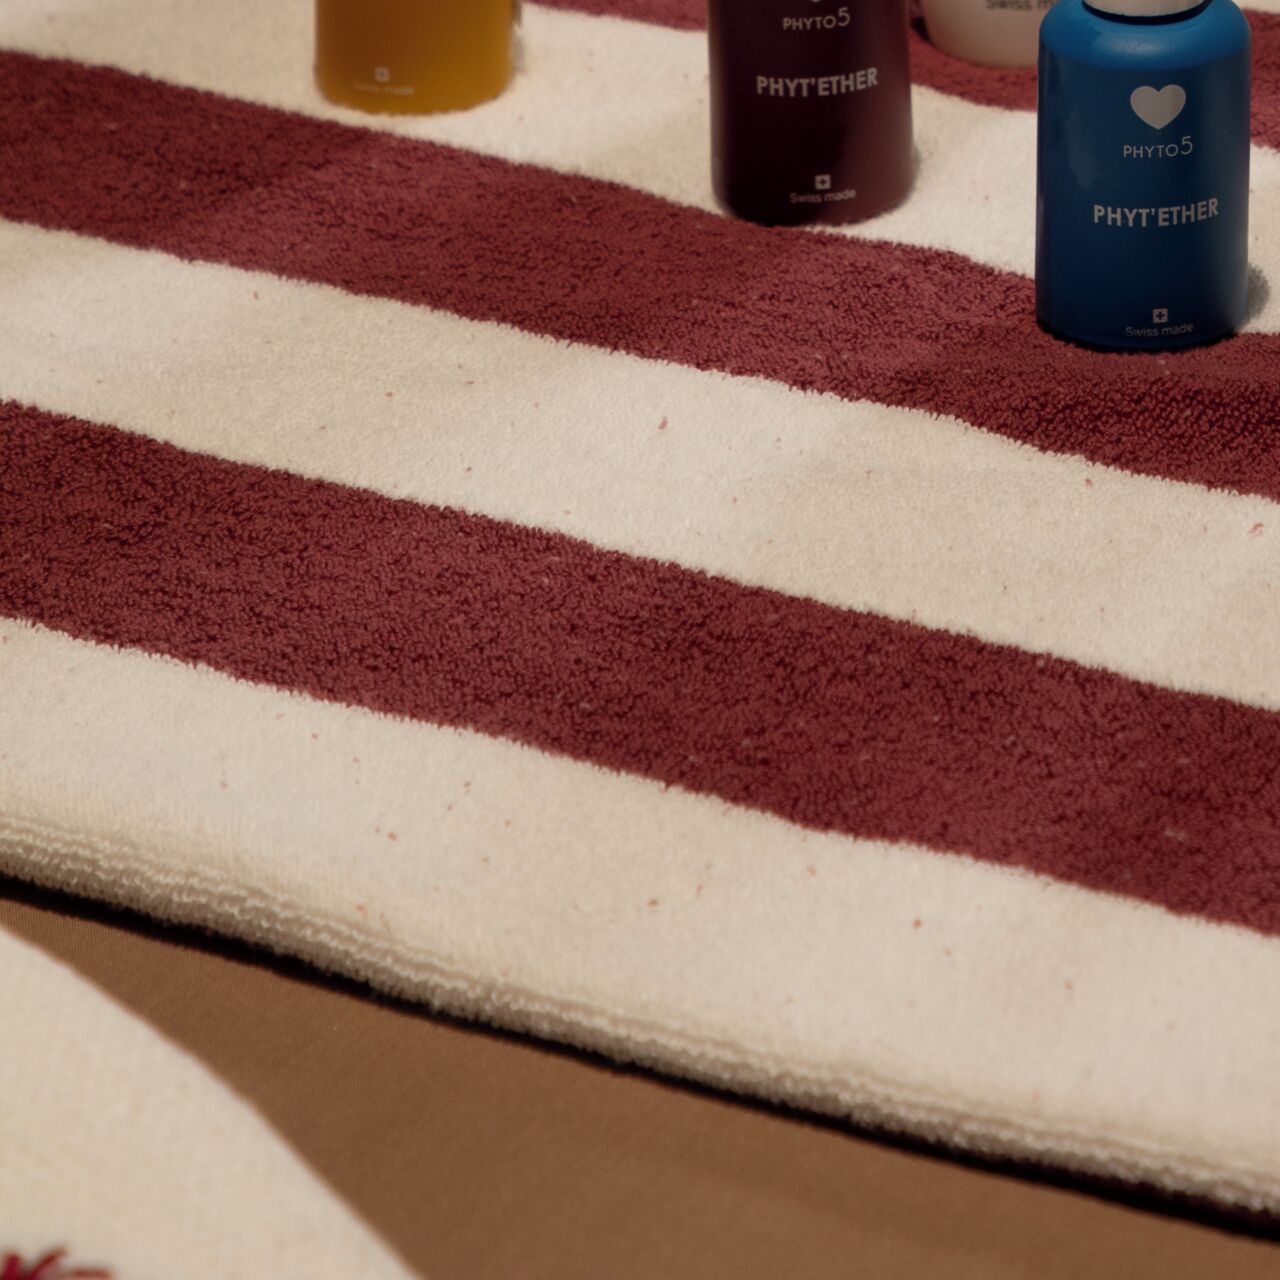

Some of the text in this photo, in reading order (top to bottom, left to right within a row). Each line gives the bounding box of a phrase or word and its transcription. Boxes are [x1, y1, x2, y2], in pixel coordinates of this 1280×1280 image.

[782, 7, 851, 30] PHYTO5
[756, 67, 878, 97] PHYT'ETHER
[1123, 135, 1193, 158] PHYTO5
[789, 188, 856, 204] Swiss made
[1093, 198, 1219, 227] PHYT'ETHER
[1126, 322, 1194, 337] Swiss made
